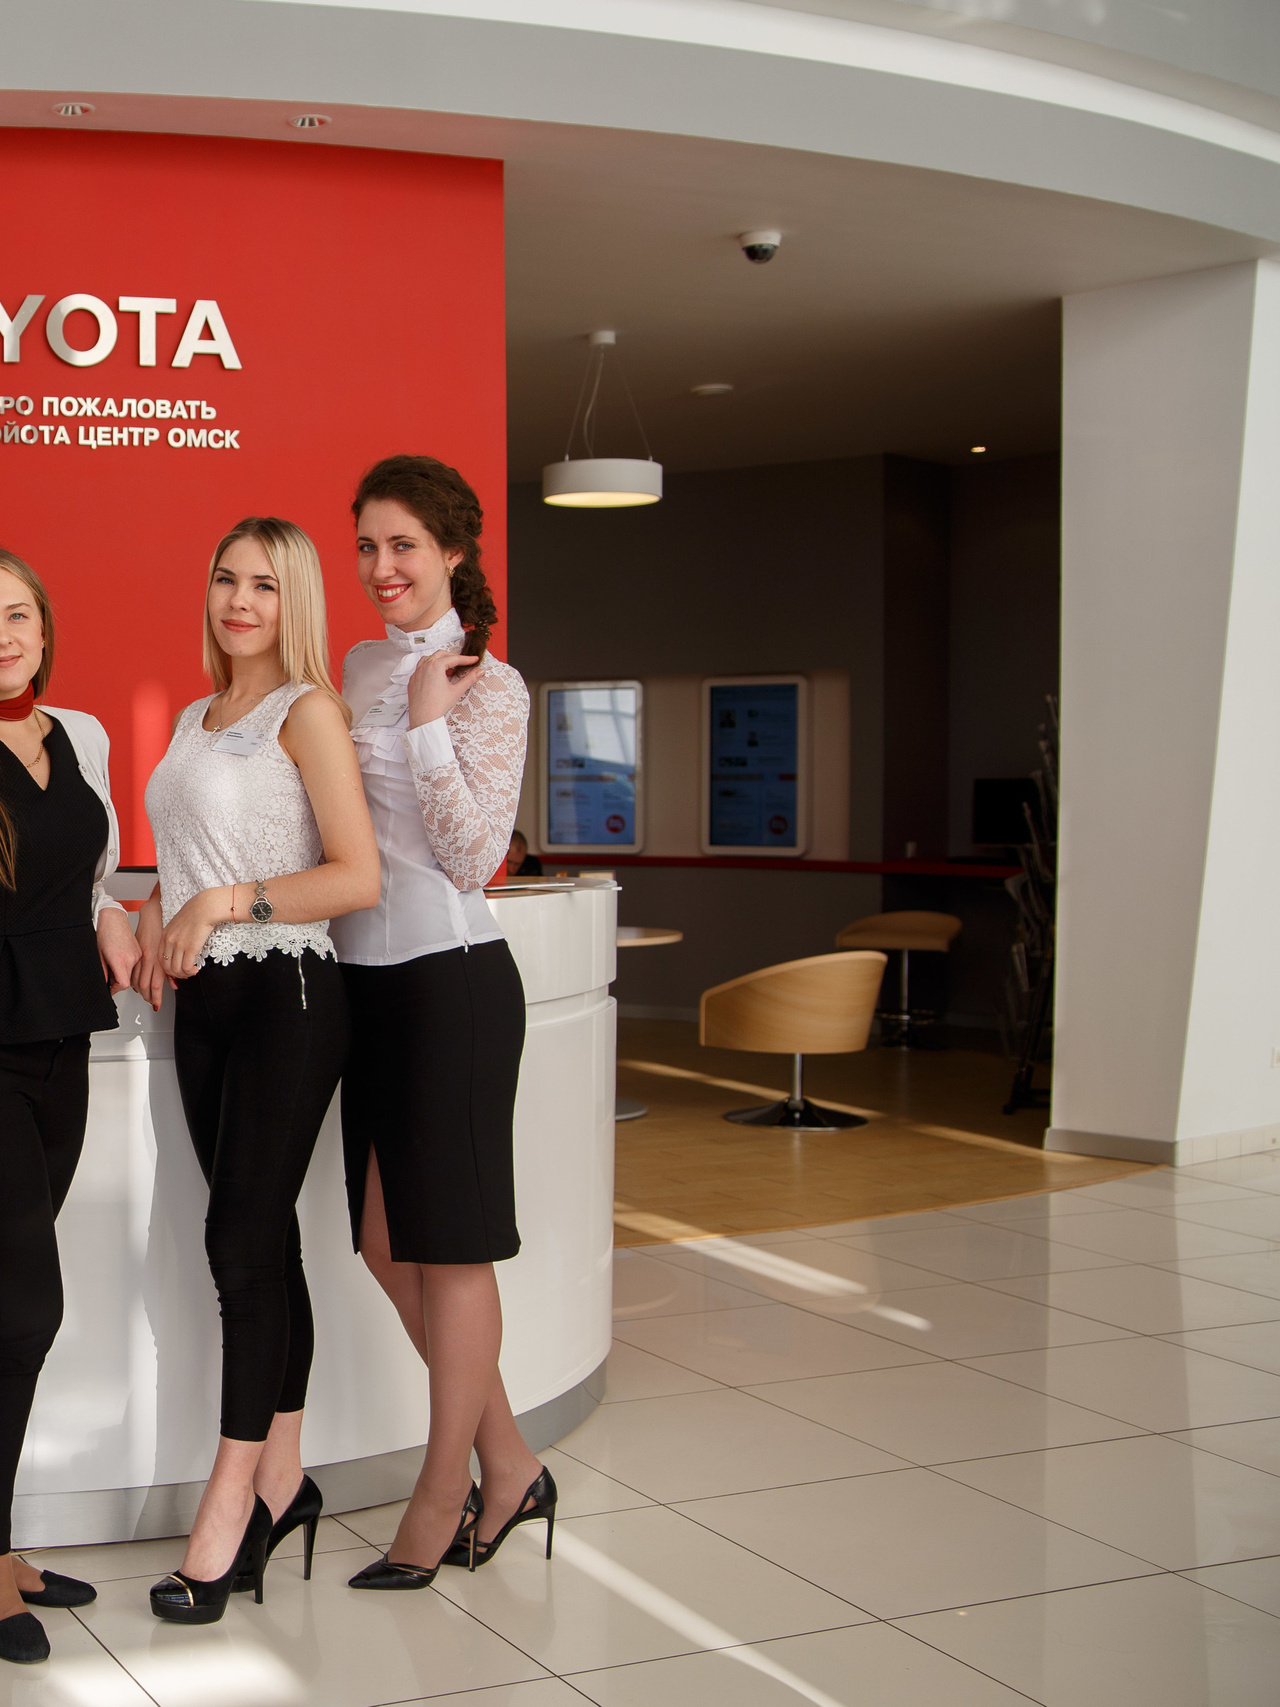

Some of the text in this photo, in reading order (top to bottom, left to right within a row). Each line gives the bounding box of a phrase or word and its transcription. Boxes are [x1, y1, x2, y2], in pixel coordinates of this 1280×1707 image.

[41, 396, 218, 420] ПОЖАЛОВАТЬ
[77, 425, 161, 449] ЦЕНТР
[166, 427, 241, 449] ОМСК
